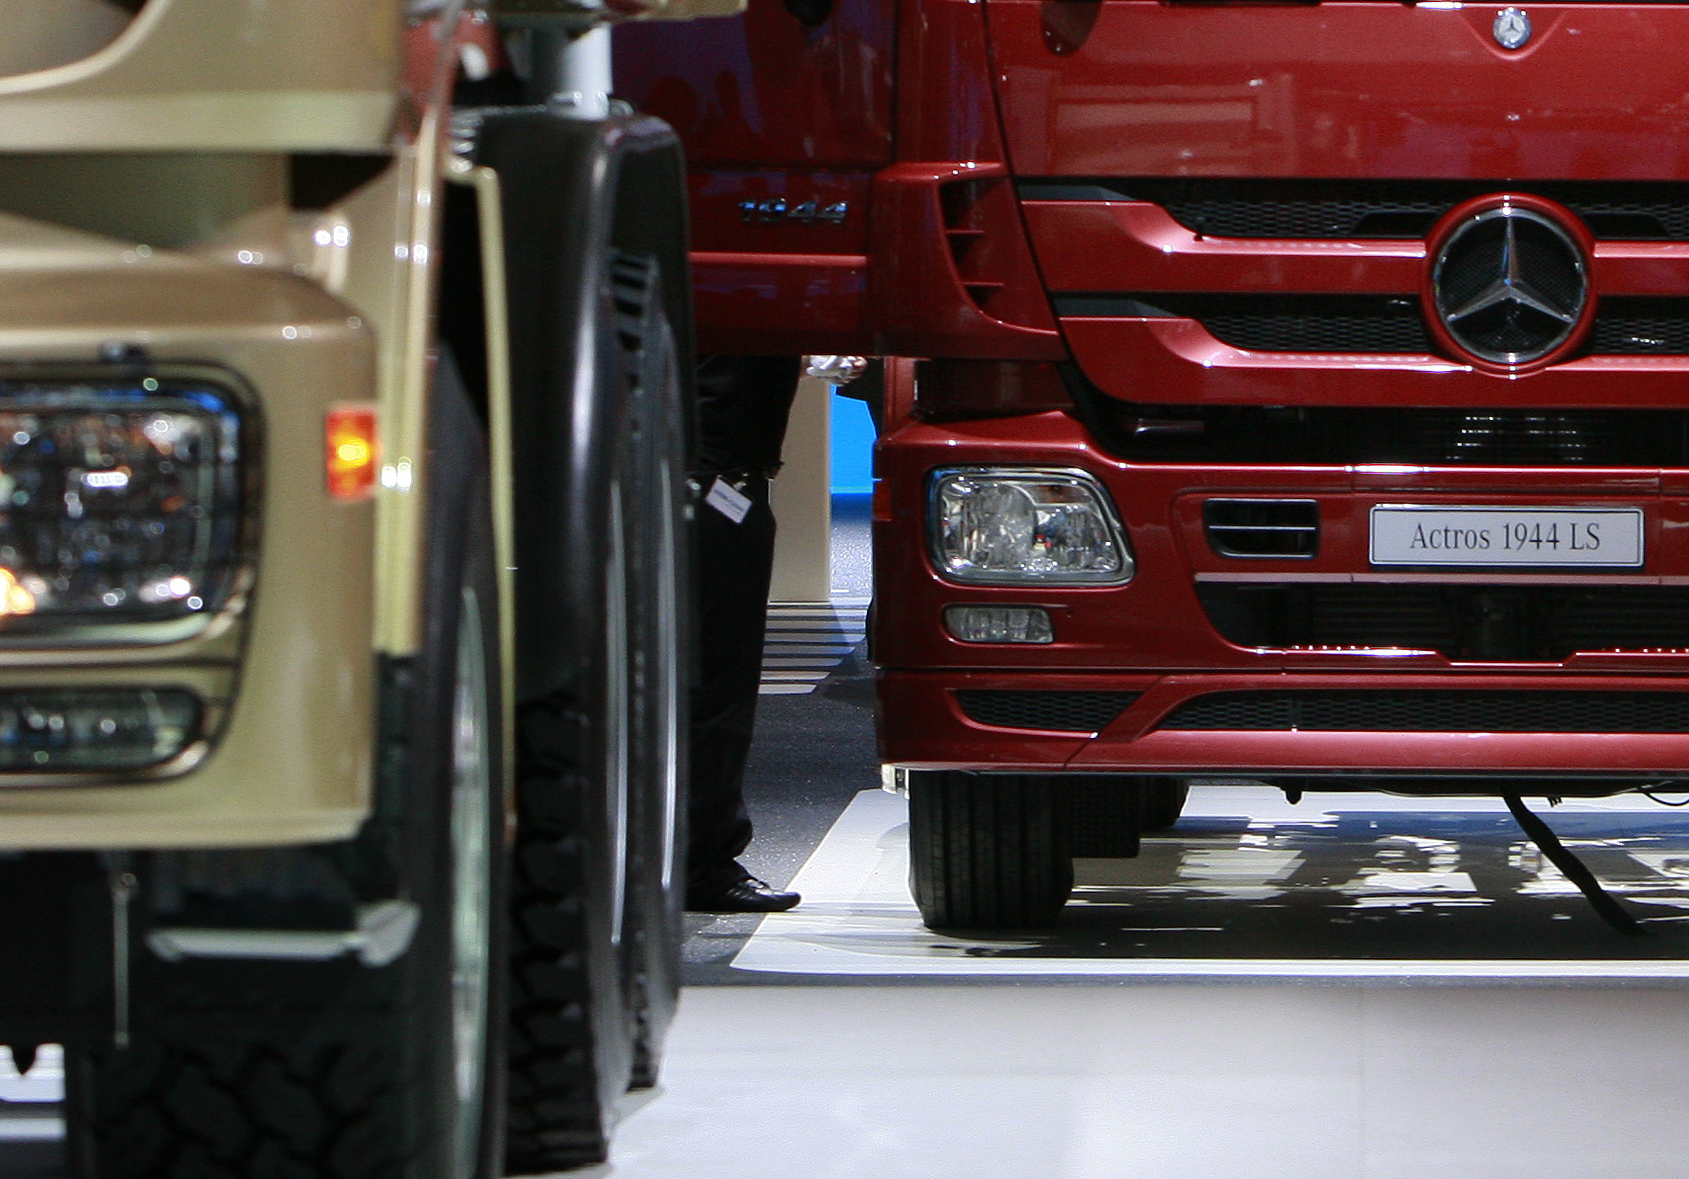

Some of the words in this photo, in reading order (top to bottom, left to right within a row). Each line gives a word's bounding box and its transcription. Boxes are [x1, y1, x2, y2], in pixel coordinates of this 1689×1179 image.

[1409, 522, 1490, 550] Actros
[1502, 522, 1560, 551] 1944
[1569, 522, 1601, 551] LS
